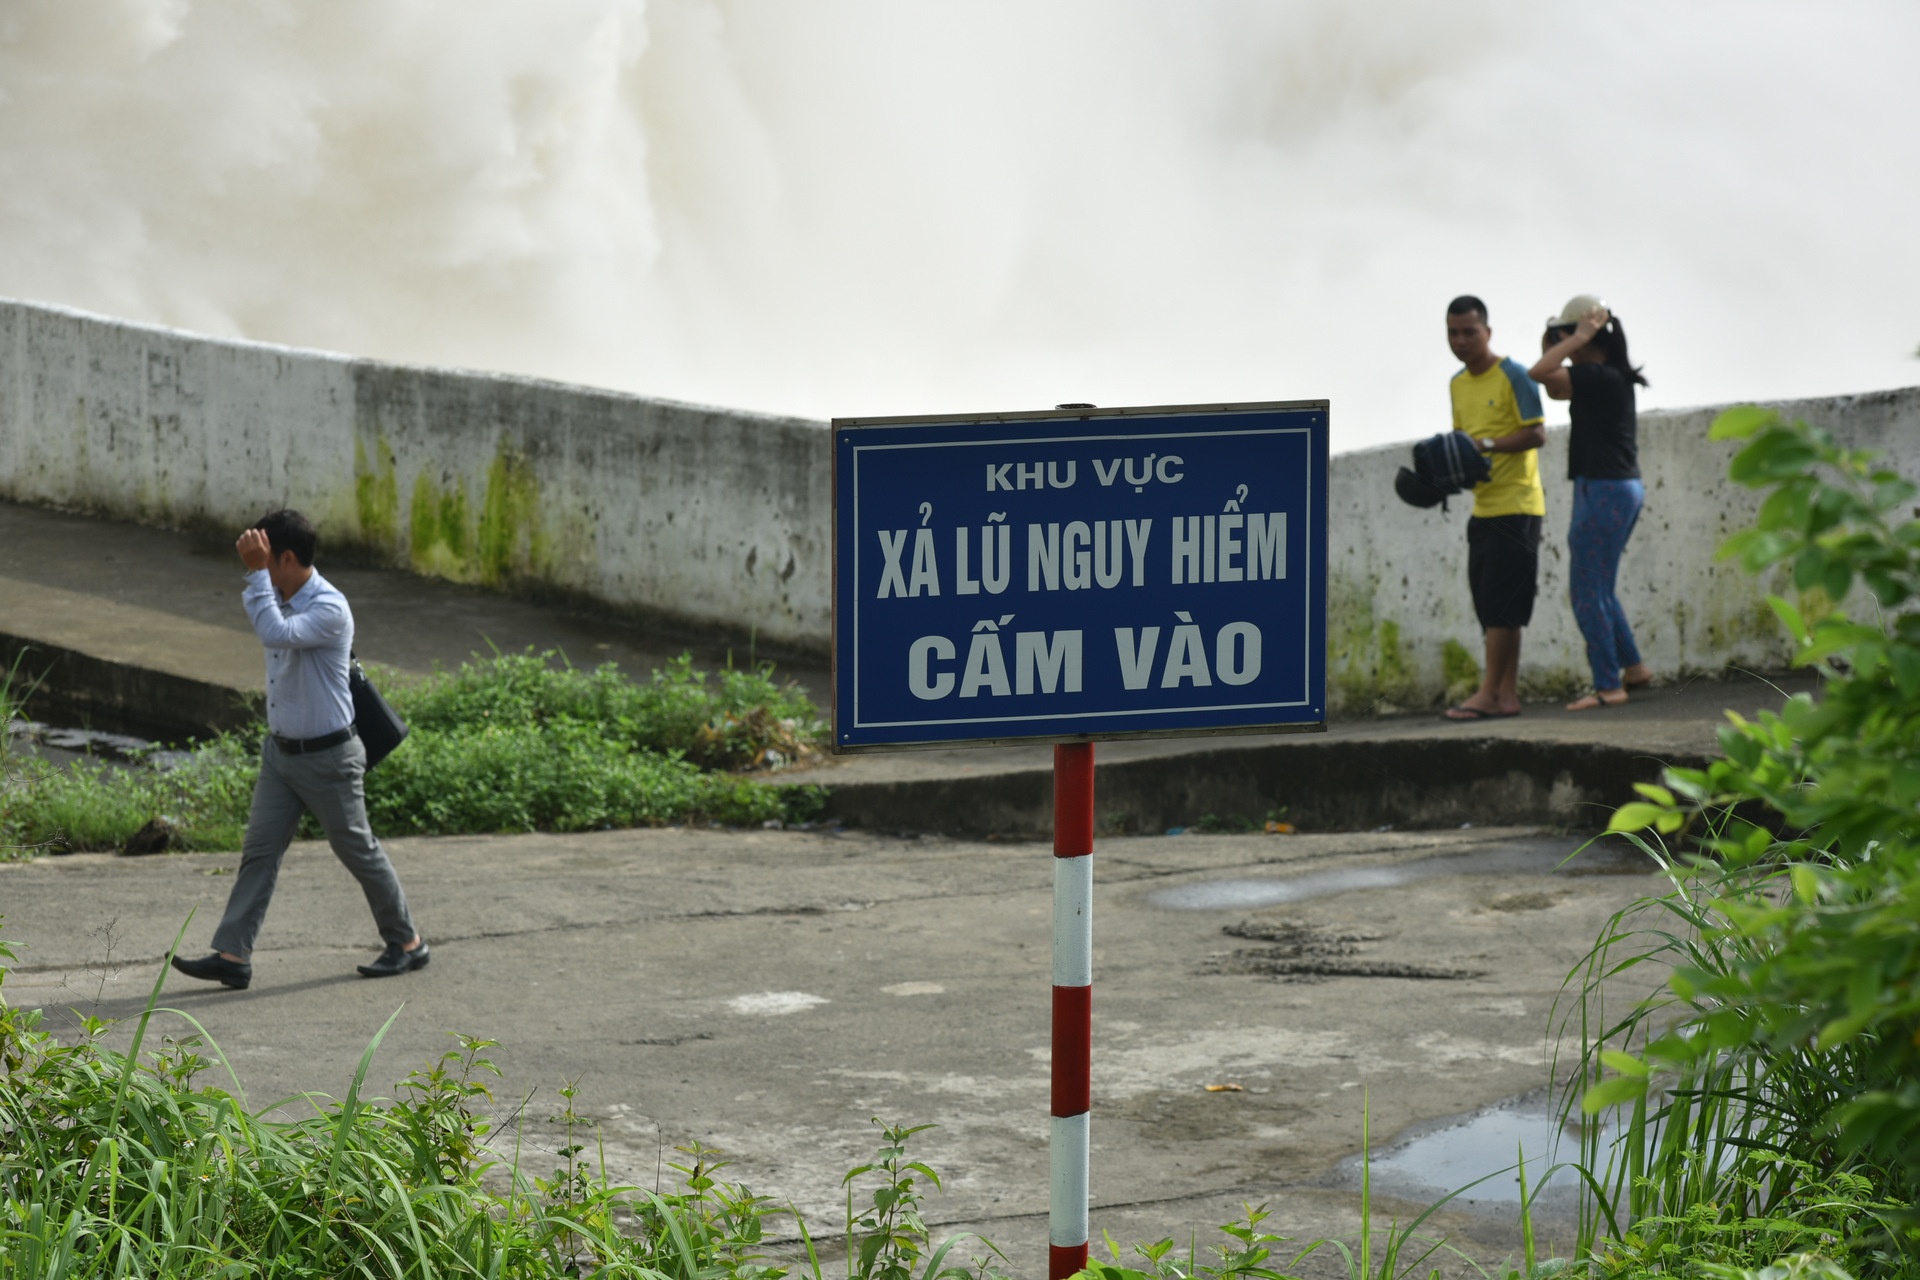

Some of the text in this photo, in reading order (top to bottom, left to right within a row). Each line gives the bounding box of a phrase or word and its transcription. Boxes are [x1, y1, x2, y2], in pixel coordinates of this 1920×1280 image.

[986, 453, 1185, 493] KHU VỰC
[876, 483, 1287, 599] XẢ LŨ NGUY HIỂM
[908, 611, 1263, 701] CẤM VÀO
